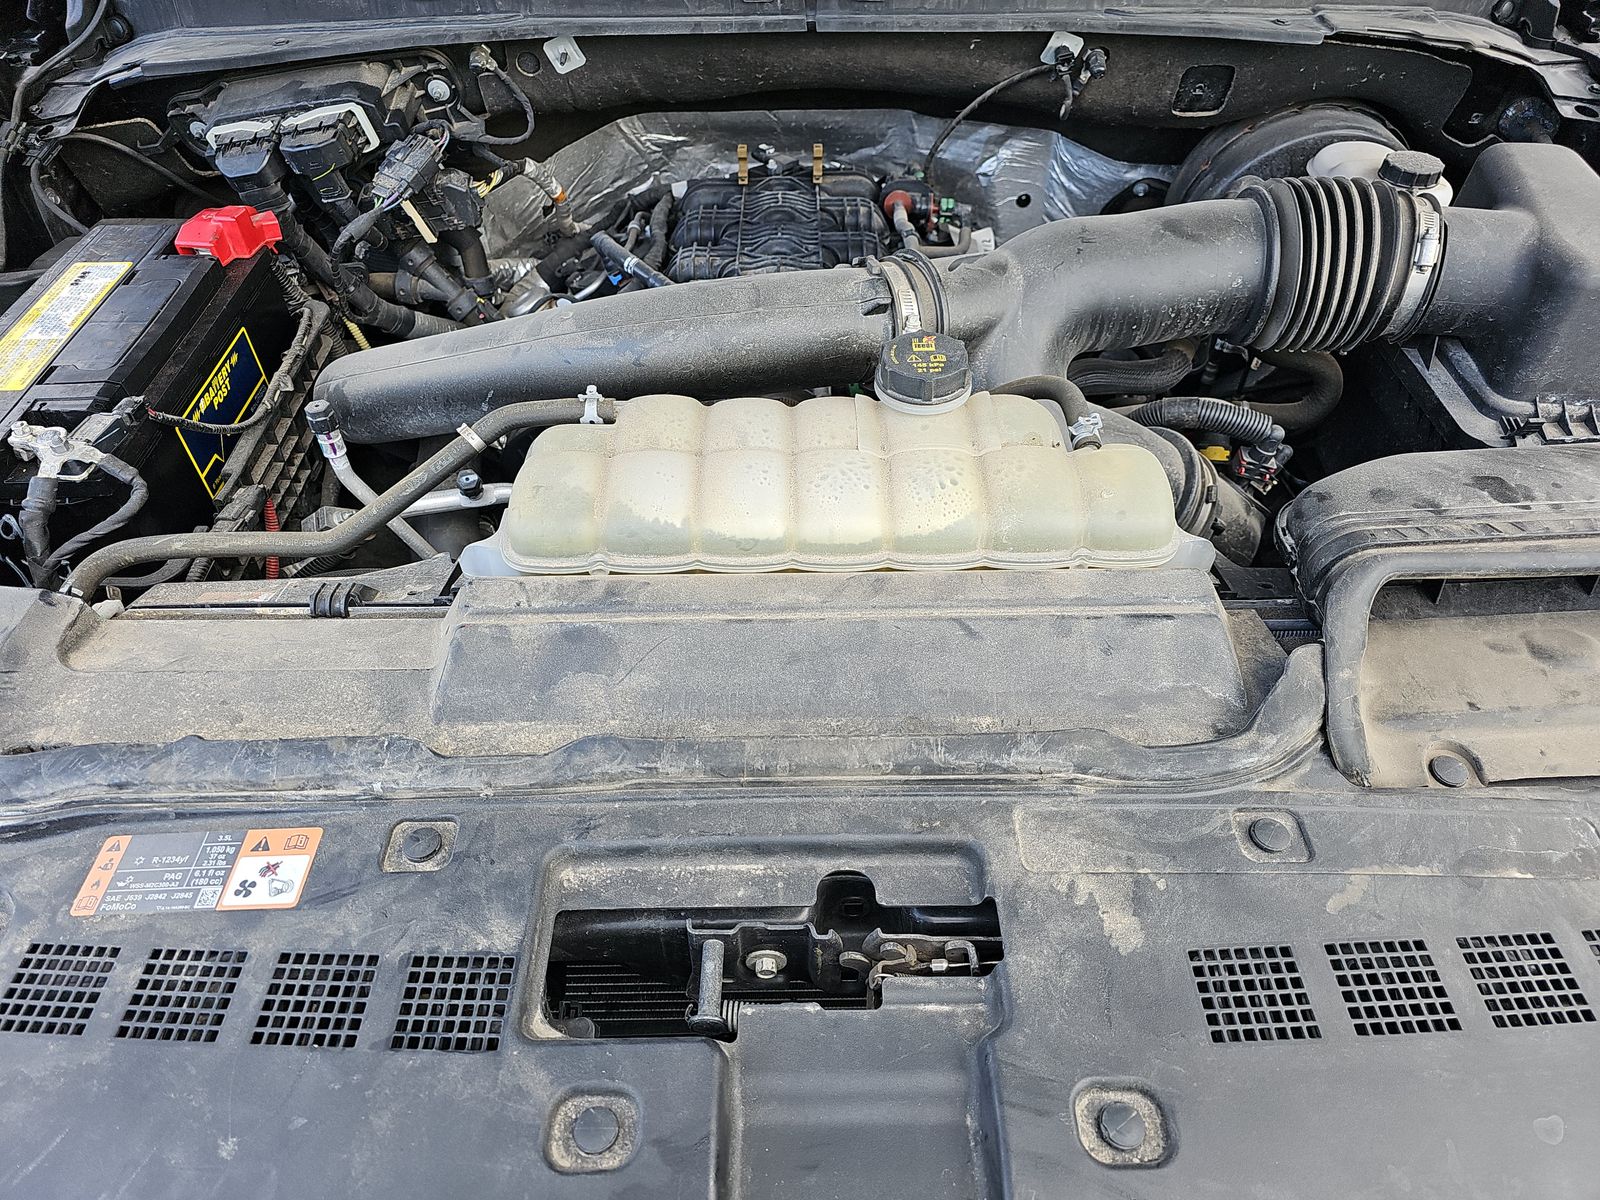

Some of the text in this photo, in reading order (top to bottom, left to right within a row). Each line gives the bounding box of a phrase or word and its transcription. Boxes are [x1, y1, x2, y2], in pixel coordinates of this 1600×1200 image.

[203, 359, 231, 407] BATTERY
[213, 377, 231, 411] POST
[206, 845, 236, 855] 1.050 kg
[151, 855, 190, 865] R-1234yf
[163, 872, 184, 881] PAG
[194, 870, 207, 878] 6.1
[209, 877, 223, 886] cc)
[104, 894, 122, 902] SAE
[99, 902, 137, 912] FoMoCo
